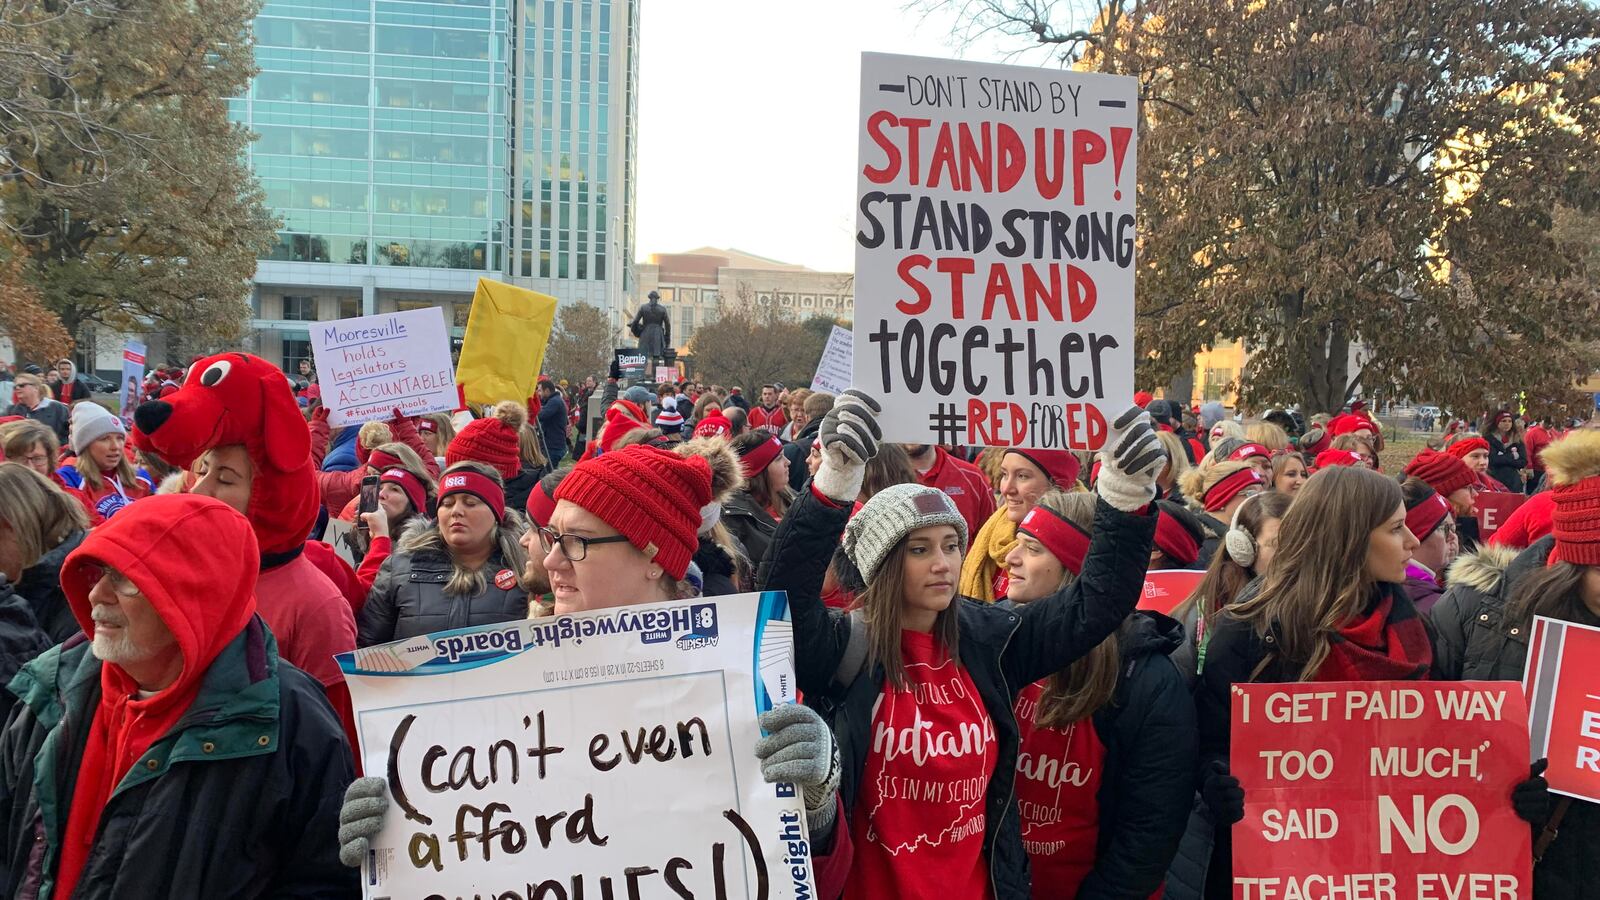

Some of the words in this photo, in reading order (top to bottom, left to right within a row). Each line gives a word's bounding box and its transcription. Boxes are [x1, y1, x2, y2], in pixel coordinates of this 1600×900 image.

[907, 75, 968, 109] DON'T
[978, 77, 1042, 112] STAND
[1050, 81, 1081, 117] BY
[863, 110, 1027, 193] STAND
[1034, 127, 1133, 206] UP!
[857, 191, 993, 254] STAND
[996, 208, 1136, 268] STRONG
[896, 254, 1097, 323] STAND
[325, 318, 408, 345] Mooresville
[343, 345, 386, 363] holds
[618, 353, 646, 366] Bernie
[331, 359, 407, 387] legislators
[338, 368, 454, 406] ACCOUNTABLE!
[533, 608, 690, 647] Heavyweight
[700, 607, 713, 628] 8
[407, 645, 430, 653] WHITE
[436, 629, 522, 660] Boards
[645, 632, 668, 641] WHITE
[676, 636, 720, 651] ArtSkills
[1264, 692, 1337, 724] GET
[1345, 689, 1425, 721] PAID
[1434, 690, 1506, 721] WAY
[588, 717, 712, 772] even
[1259, 749, 1334, 781] TOO
[883, 776, 897, 799] IS
[902, 777, 920, 800] IN
[923, 781, 944, 803] MY
[408, 793, 609, 873] afford
[1262, 808, 1339, 842] SAID
[1377, 794, 1480, 855] NO
[1234, 873, 1397, 900] TEACHER
[1416, 873, 1519, 900] EVER
